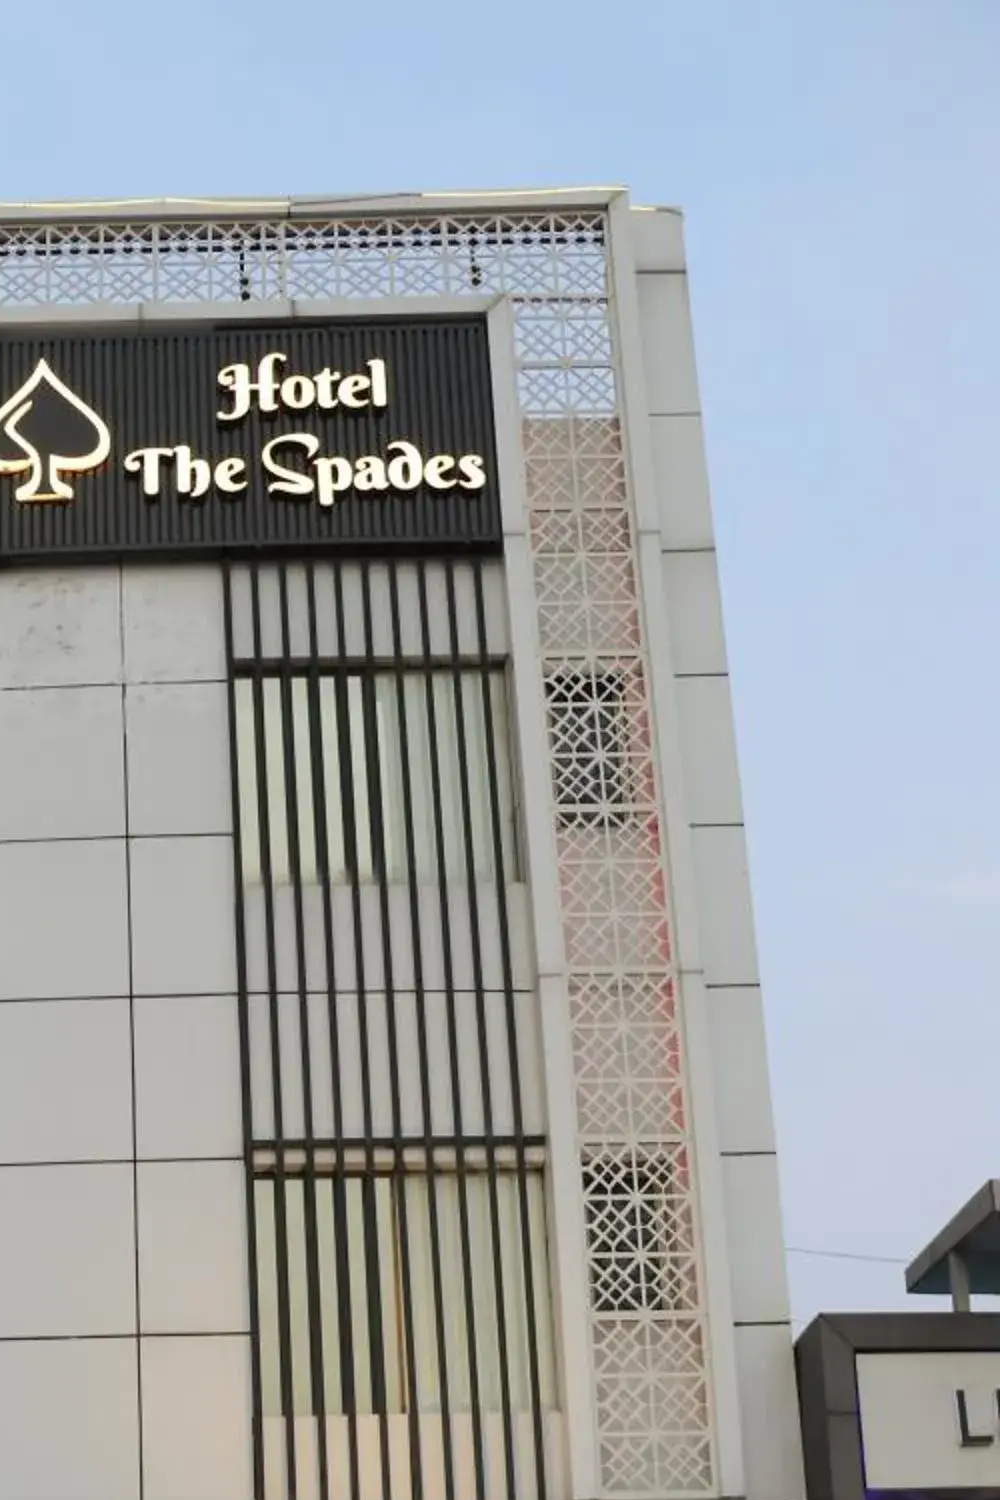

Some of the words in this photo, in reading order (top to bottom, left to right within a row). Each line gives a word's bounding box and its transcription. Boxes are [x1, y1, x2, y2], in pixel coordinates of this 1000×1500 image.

[216, 351, 387, 421] Hotel
[123, 444, 248, 497] The
[261, 432, 486, 506] Spades
[955, 1388, 1000, 1448] L
